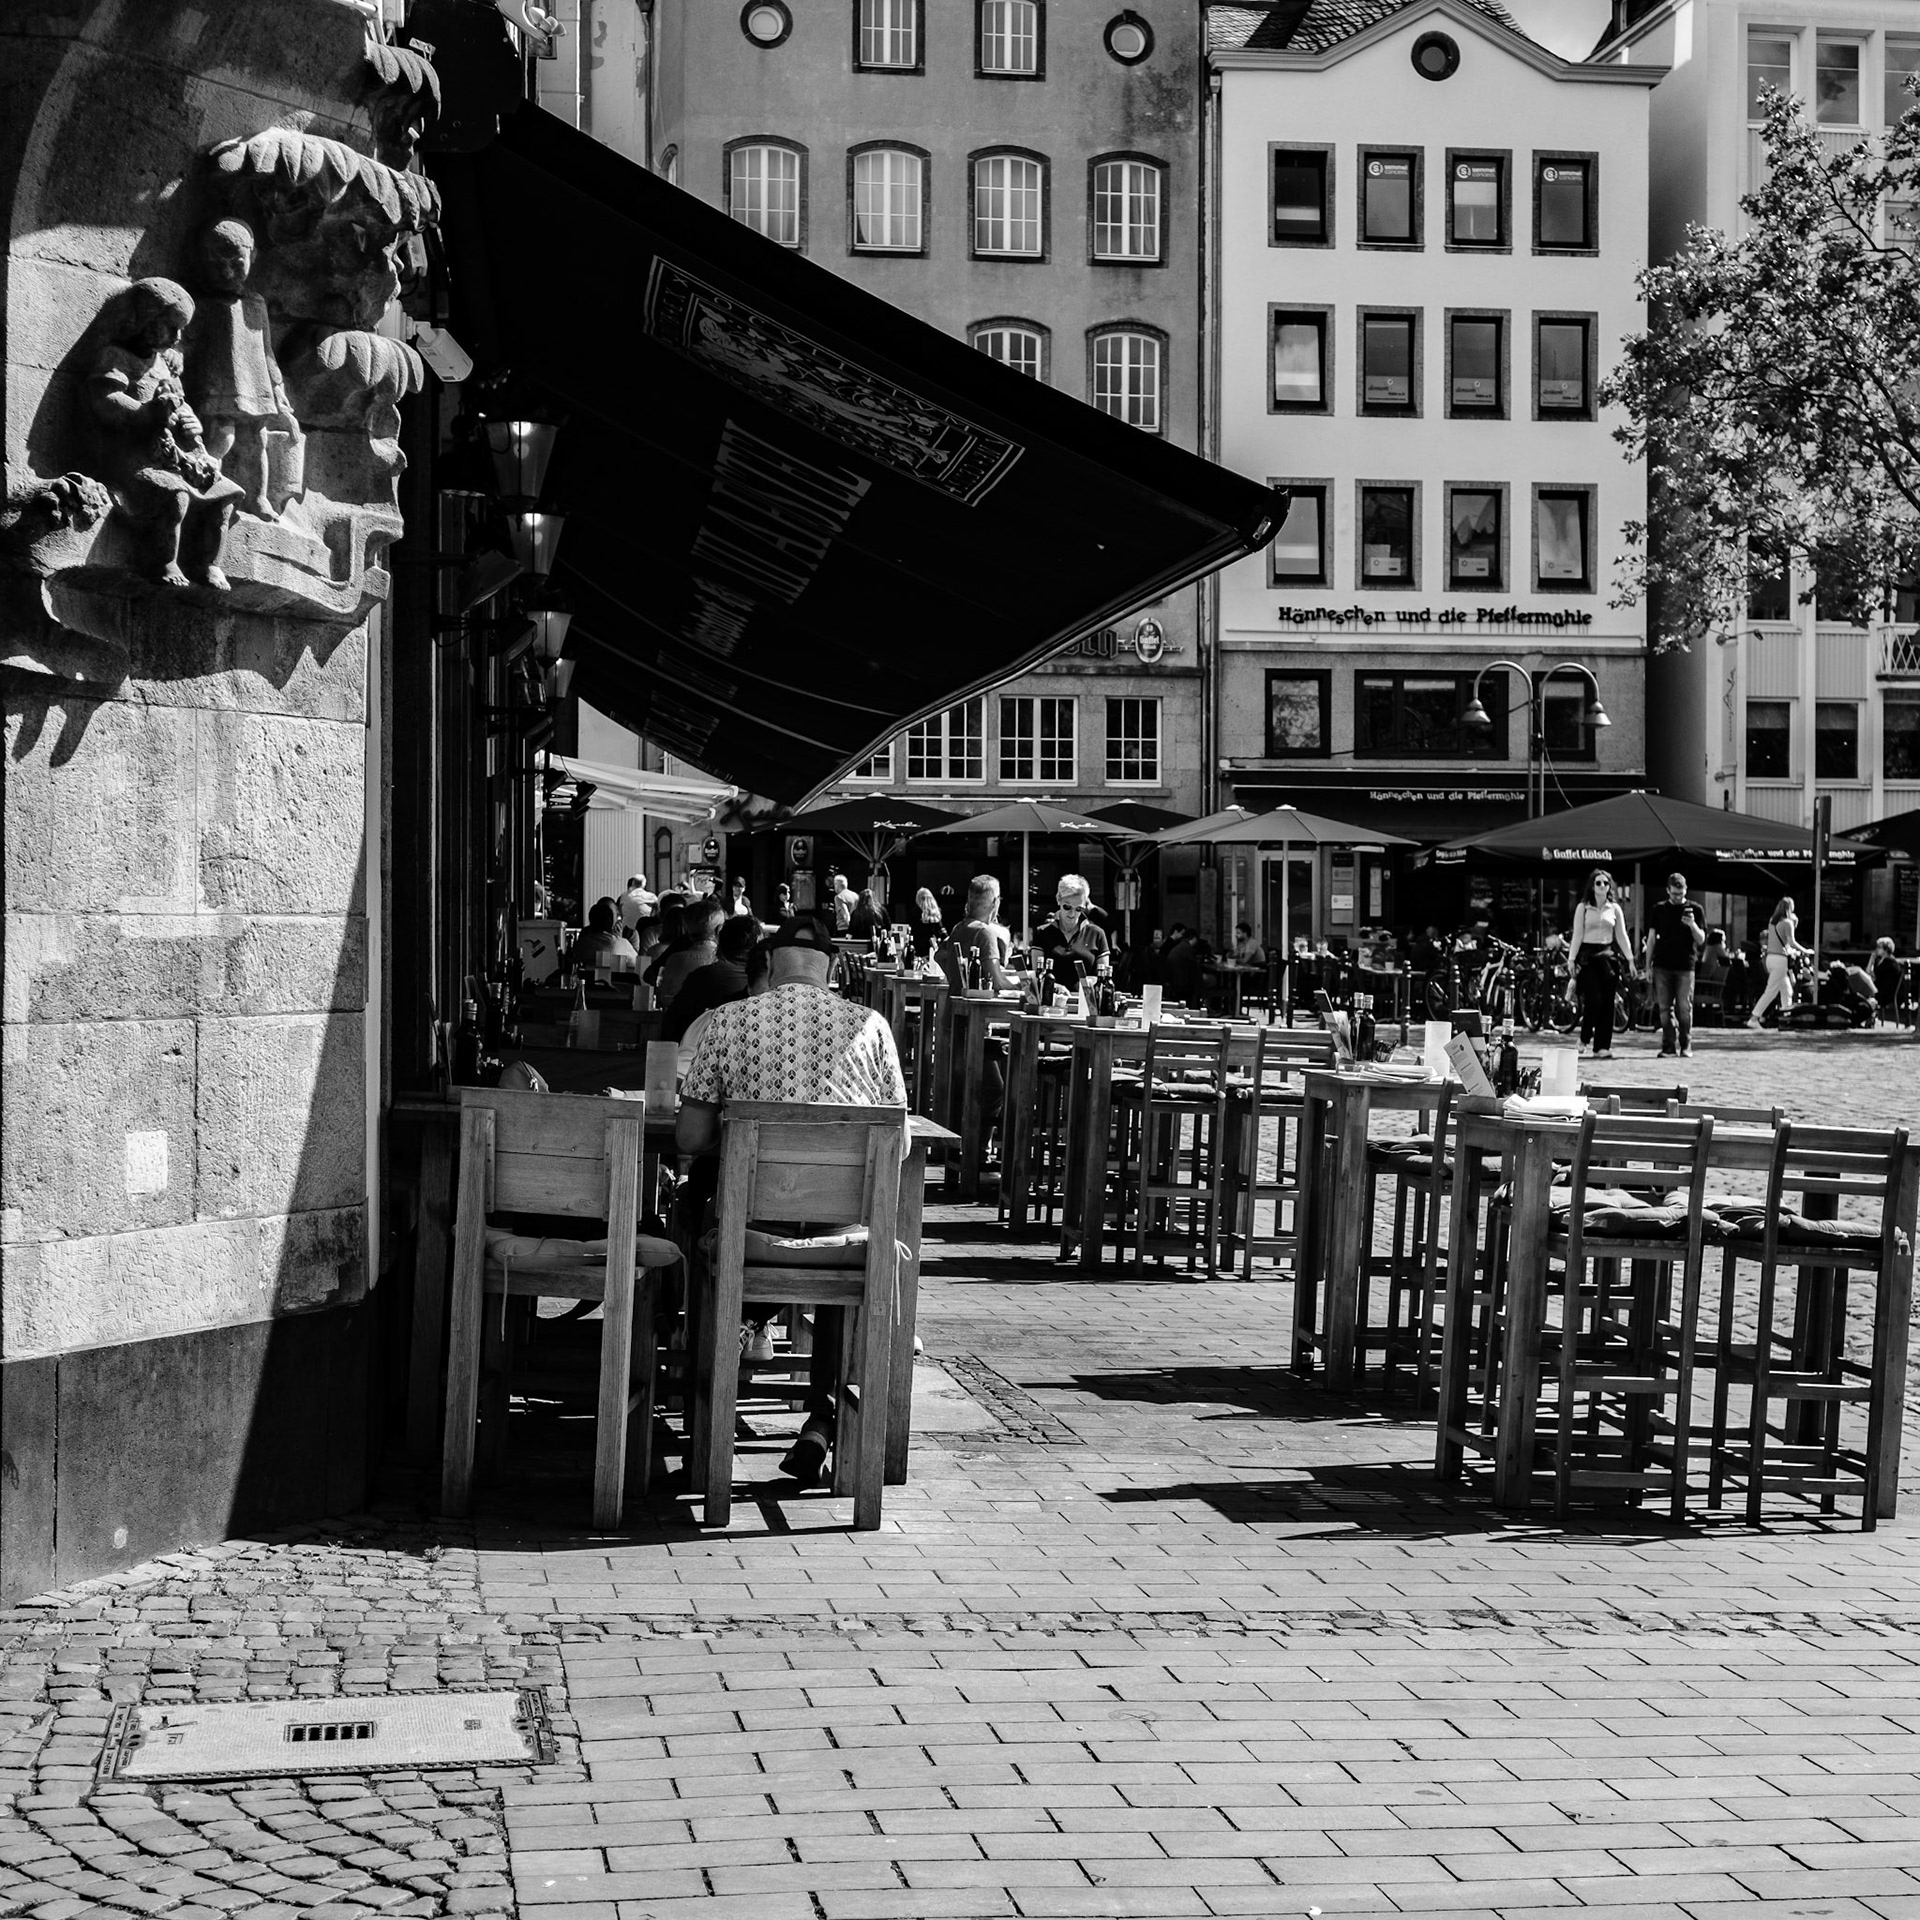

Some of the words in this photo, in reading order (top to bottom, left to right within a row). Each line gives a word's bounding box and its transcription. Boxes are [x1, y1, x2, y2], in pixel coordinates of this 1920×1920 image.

[1279, 605, 1386, 625] Hänneschen
[1396, 607, 1432, 622] und
[1438, 607, 1467, 624] die
[1477, 605, 1592, 627] Pfeffermühle
[1370, 790, 1424, 801] Hänneschen
[1427, 791, 1445, 800] und
[1448, 791, 1464, 801] die
[1467, 789, 1526, 802] Pfeffermühle
[1553, 848, 1581, 860] Gaffel
[1767, 849, 1784, 858] und
